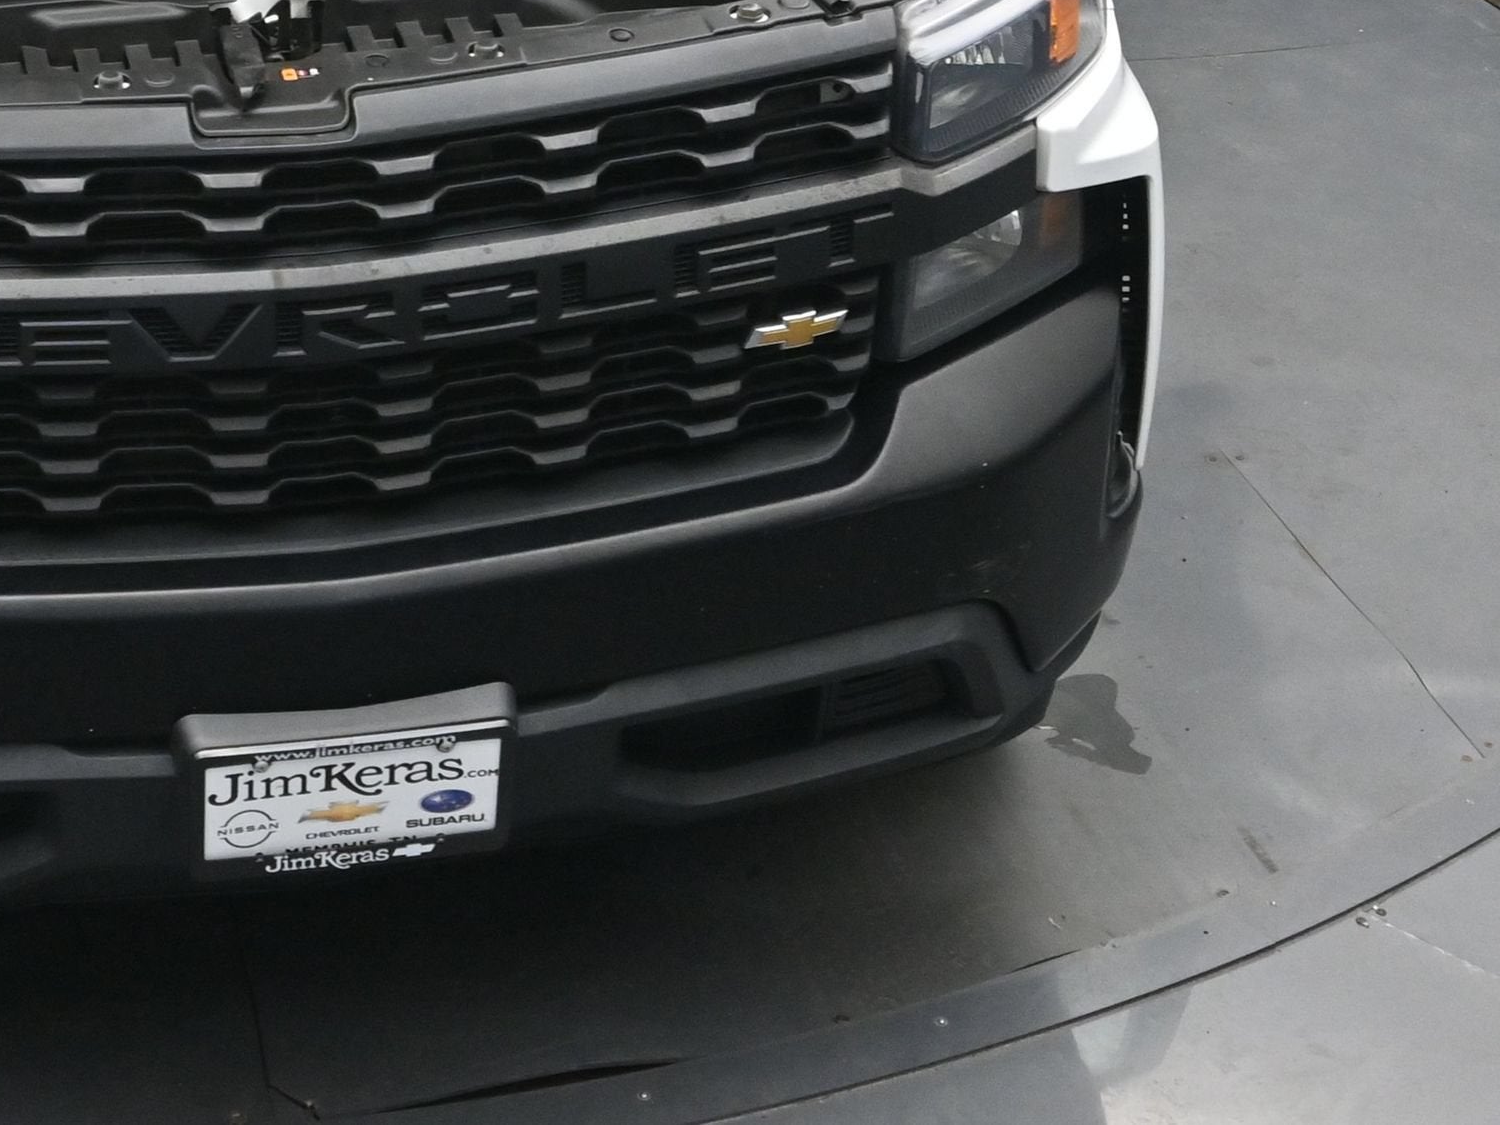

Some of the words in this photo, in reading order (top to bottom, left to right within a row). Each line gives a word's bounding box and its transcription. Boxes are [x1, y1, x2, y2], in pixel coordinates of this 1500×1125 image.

[405, 813, 485, 828] SUBARU
[217, 822, 279, 837] NISSAN
[305, 826, 380, 840] CHEVROLET
